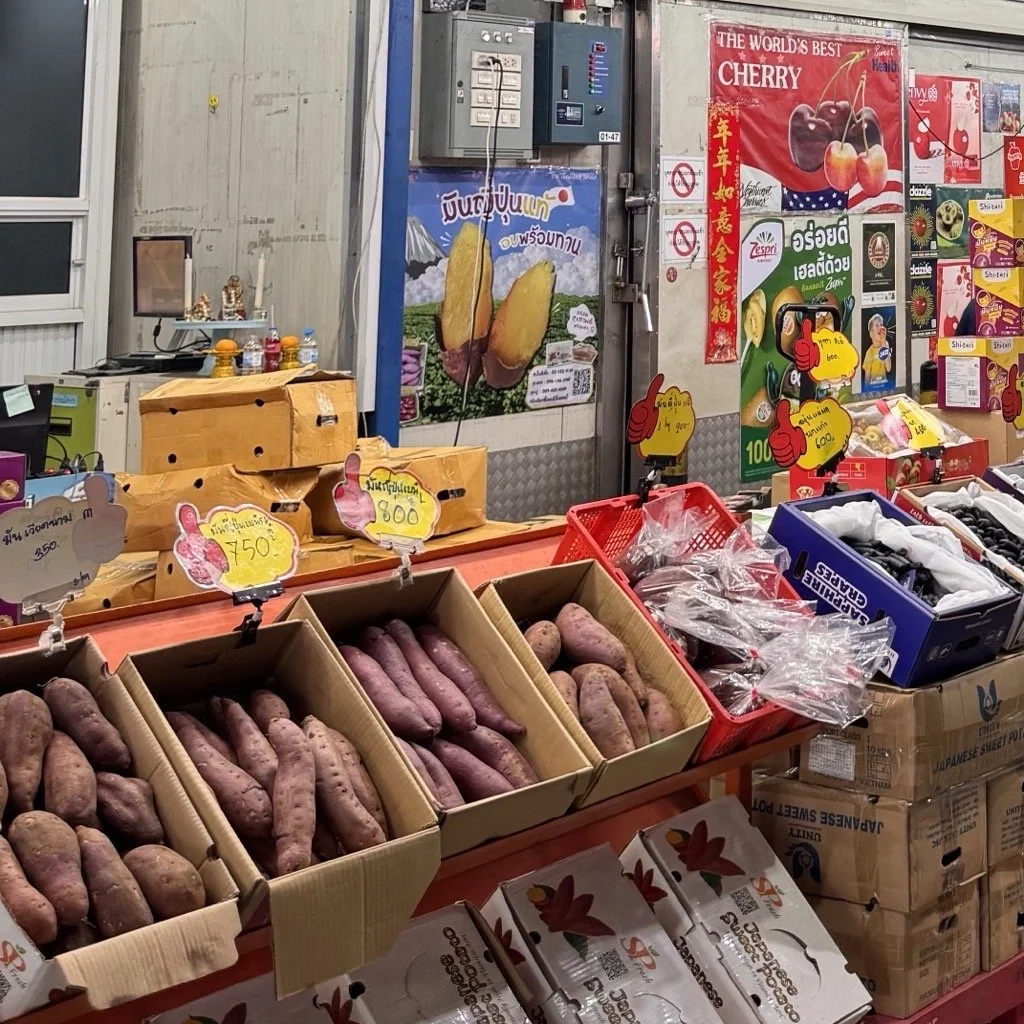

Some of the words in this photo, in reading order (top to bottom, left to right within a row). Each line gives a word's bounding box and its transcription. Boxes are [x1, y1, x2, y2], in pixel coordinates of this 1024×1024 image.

[717, 31, 745, 50] THE
[749, 34, 809, 54] WORLD'S
[811, 40, 843, 58] BEST
[717, 60, 802, 90] CHERRY
[600, 132, 619, 141] 01-47
[909, 185, 932, 197] dazzle
[792, 217, 849, 253] อร่อยดี
[749, 241, 777, 260] Zespri
[909, 262, 932, 276] dazzle
[746, 439, 772, 465] 100
[378, 499, 419, 525] 800
[801, 571, 869, 628] SAPPHIRE
[815, 561, 868, 608] GRAPES
[932, 746, 978, 775] JAPANESE
[980, 734, 1006, 756] SWEET
[750, 797, 774, 815] POT
[776, 802, 817, 823] SWEET
[787, 827, 821, 843] UNITY
[820, 810, 884, 834] JAPANESE
[751, 875, 784, 909] SP
[620, 935, 656, 971] SP
[719, 911, 761, 965] Sweet
[757, 963, 801, 1023] Potato
[742, 921, 799, 997] Japanese
[673, 935, 724, 1009] Japanese
[439, 952, 490, 1024] apanese
[583, 976, 622, 1024] Swee
